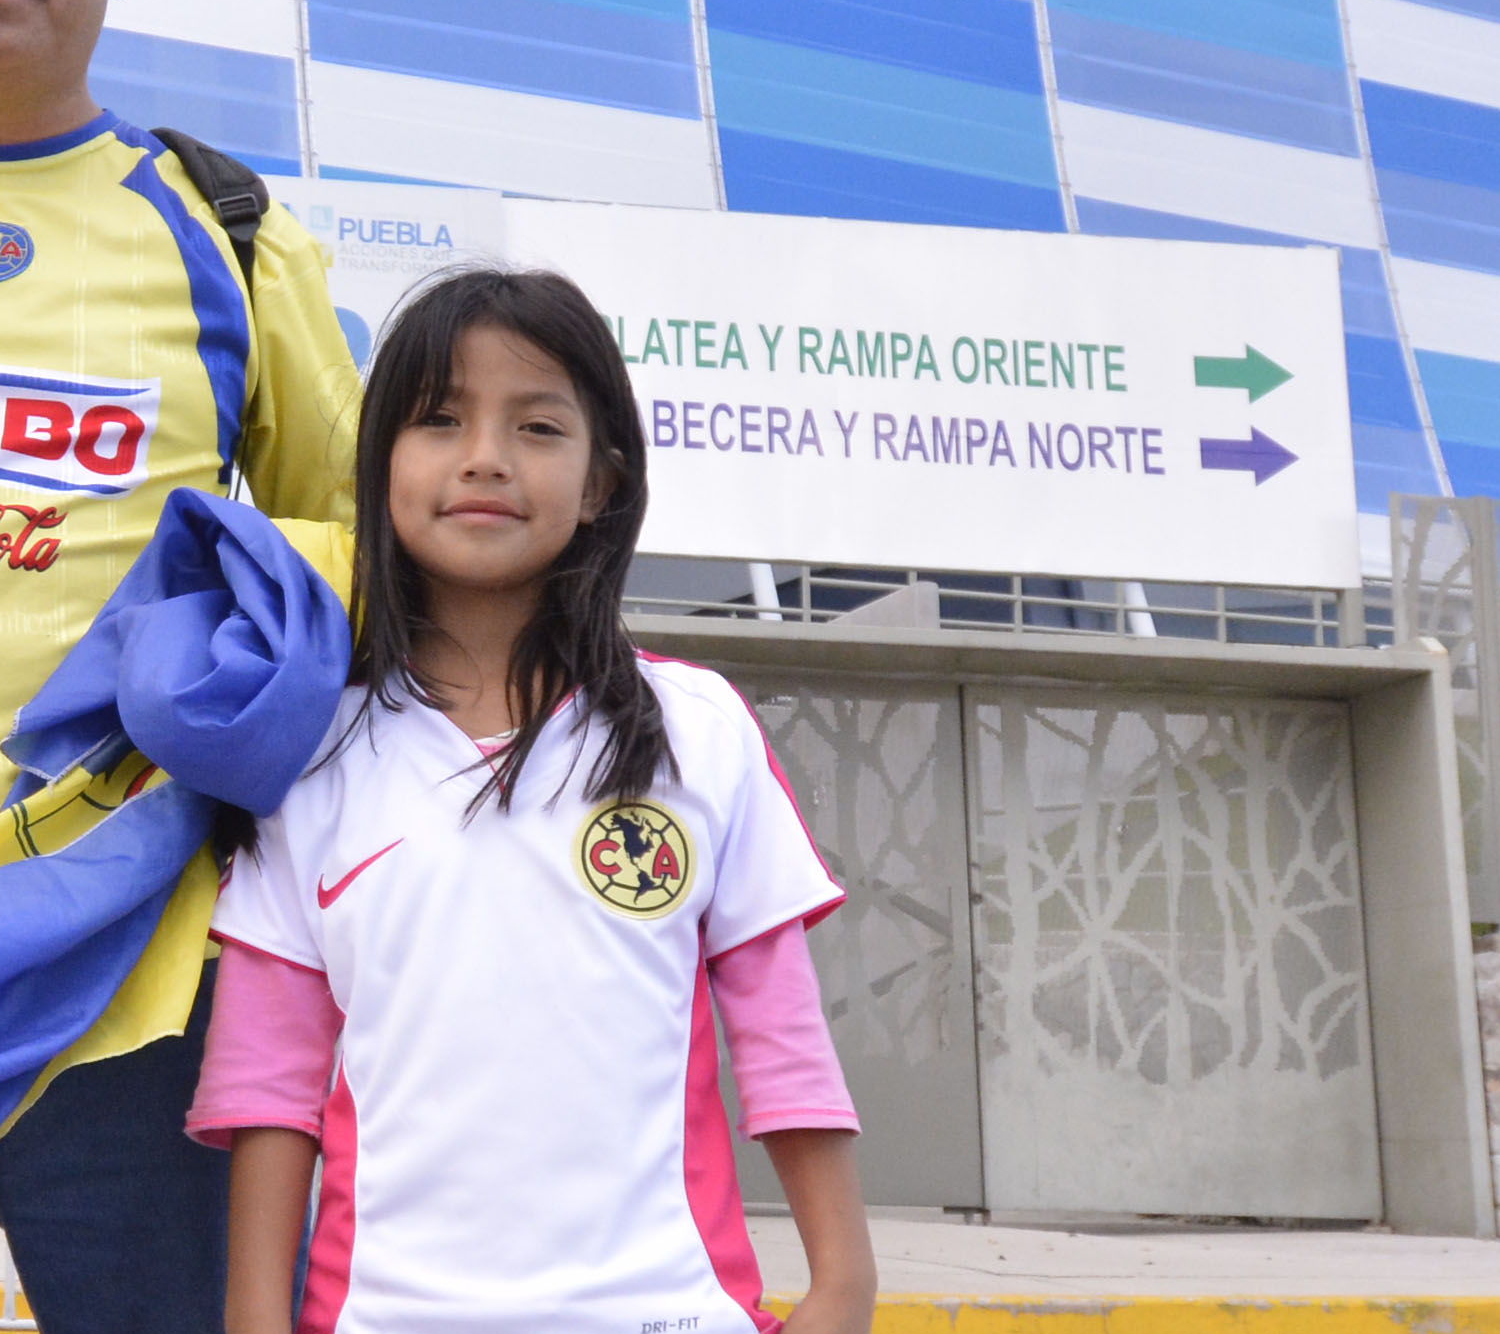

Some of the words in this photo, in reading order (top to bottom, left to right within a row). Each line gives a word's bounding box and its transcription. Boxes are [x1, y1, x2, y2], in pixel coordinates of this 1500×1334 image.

[339, 217, 454, 248] PUEBLA
[759, 324, 784, 371] Y
[799, 326, 941, 382] RAMPA
[952, 336, 1128, 392] ORIENTE
[834, 410, 860, 458] Y
[874, 413, 1017, 467] RAMPA
[1028, 422, 1166, 476] NORTE
[641, 1316, 700, 1334] DRI-FIT
